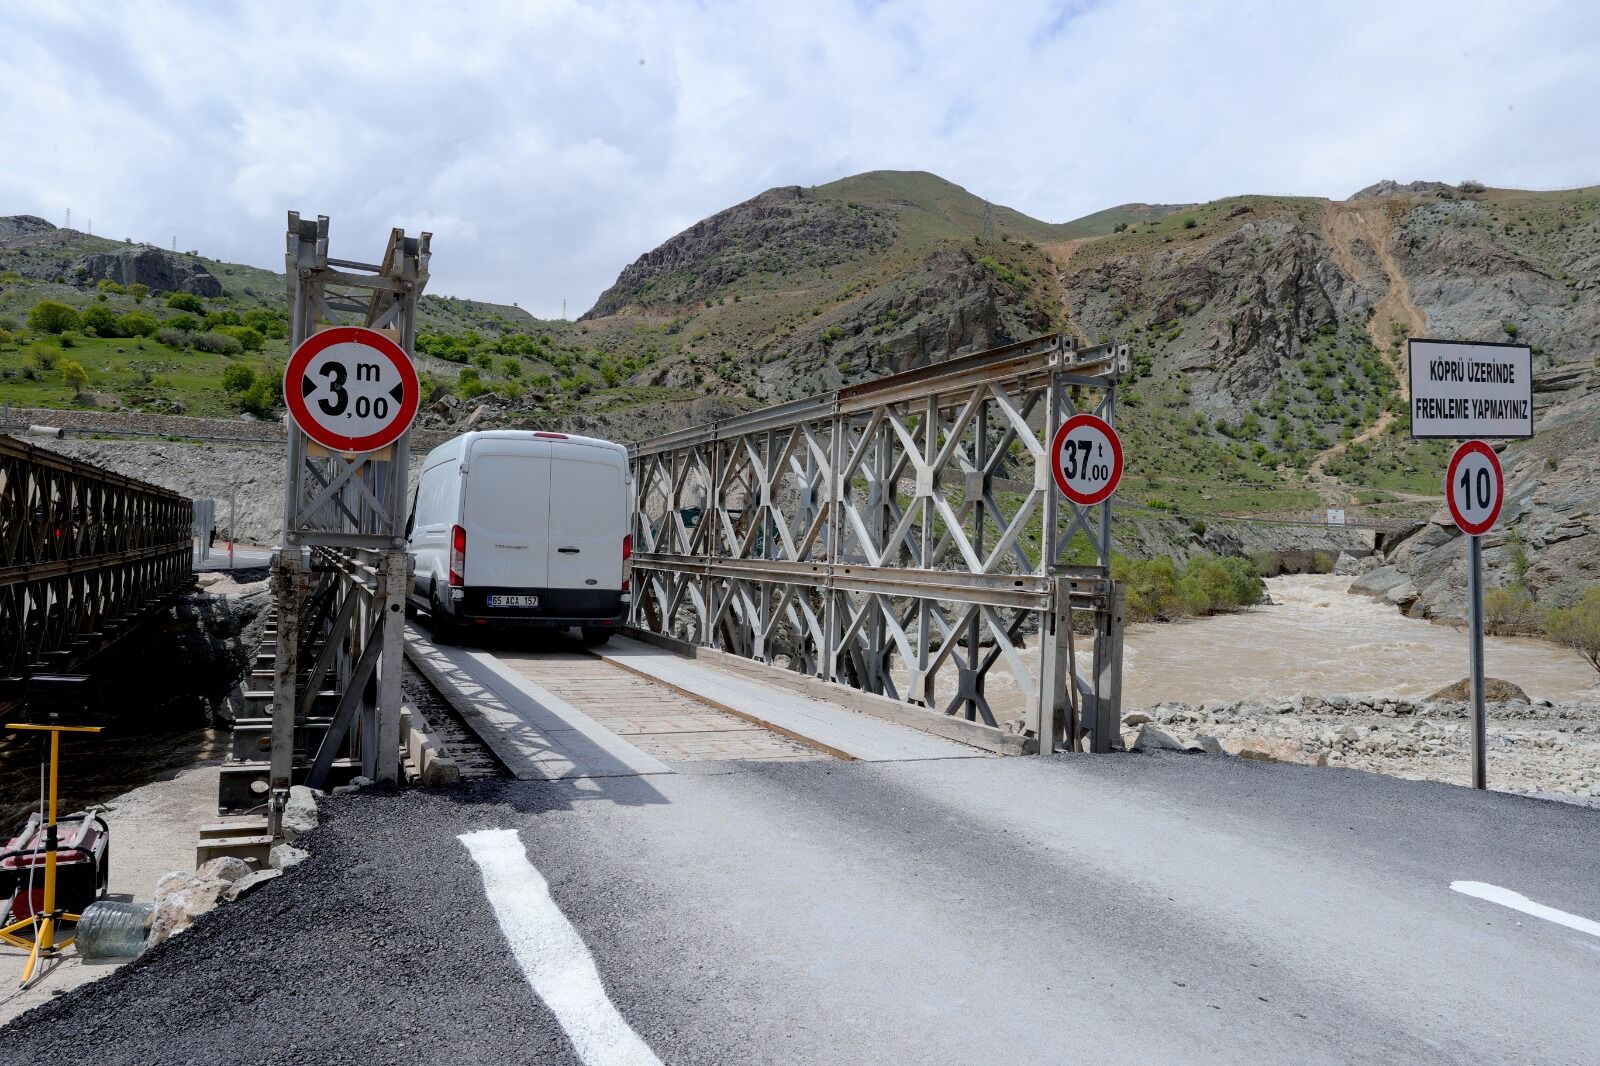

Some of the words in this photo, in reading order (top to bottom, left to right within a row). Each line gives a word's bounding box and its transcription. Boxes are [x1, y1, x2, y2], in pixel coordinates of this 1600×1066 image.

[356, 363, 381, 382] m
[1430, 356, 1464, 382] KÖPRÜ
[1467, 357, 1515, 384] ÜZERİNDE
[1415, 397, 1469, 419] FRENLEME
[1471, 398, 1528, 420] YAPMAYINIZ
[1460, 467, 1490, 510] 10
[492, 596, 502, 605] 65
[524, 596, 537, 606] 157
